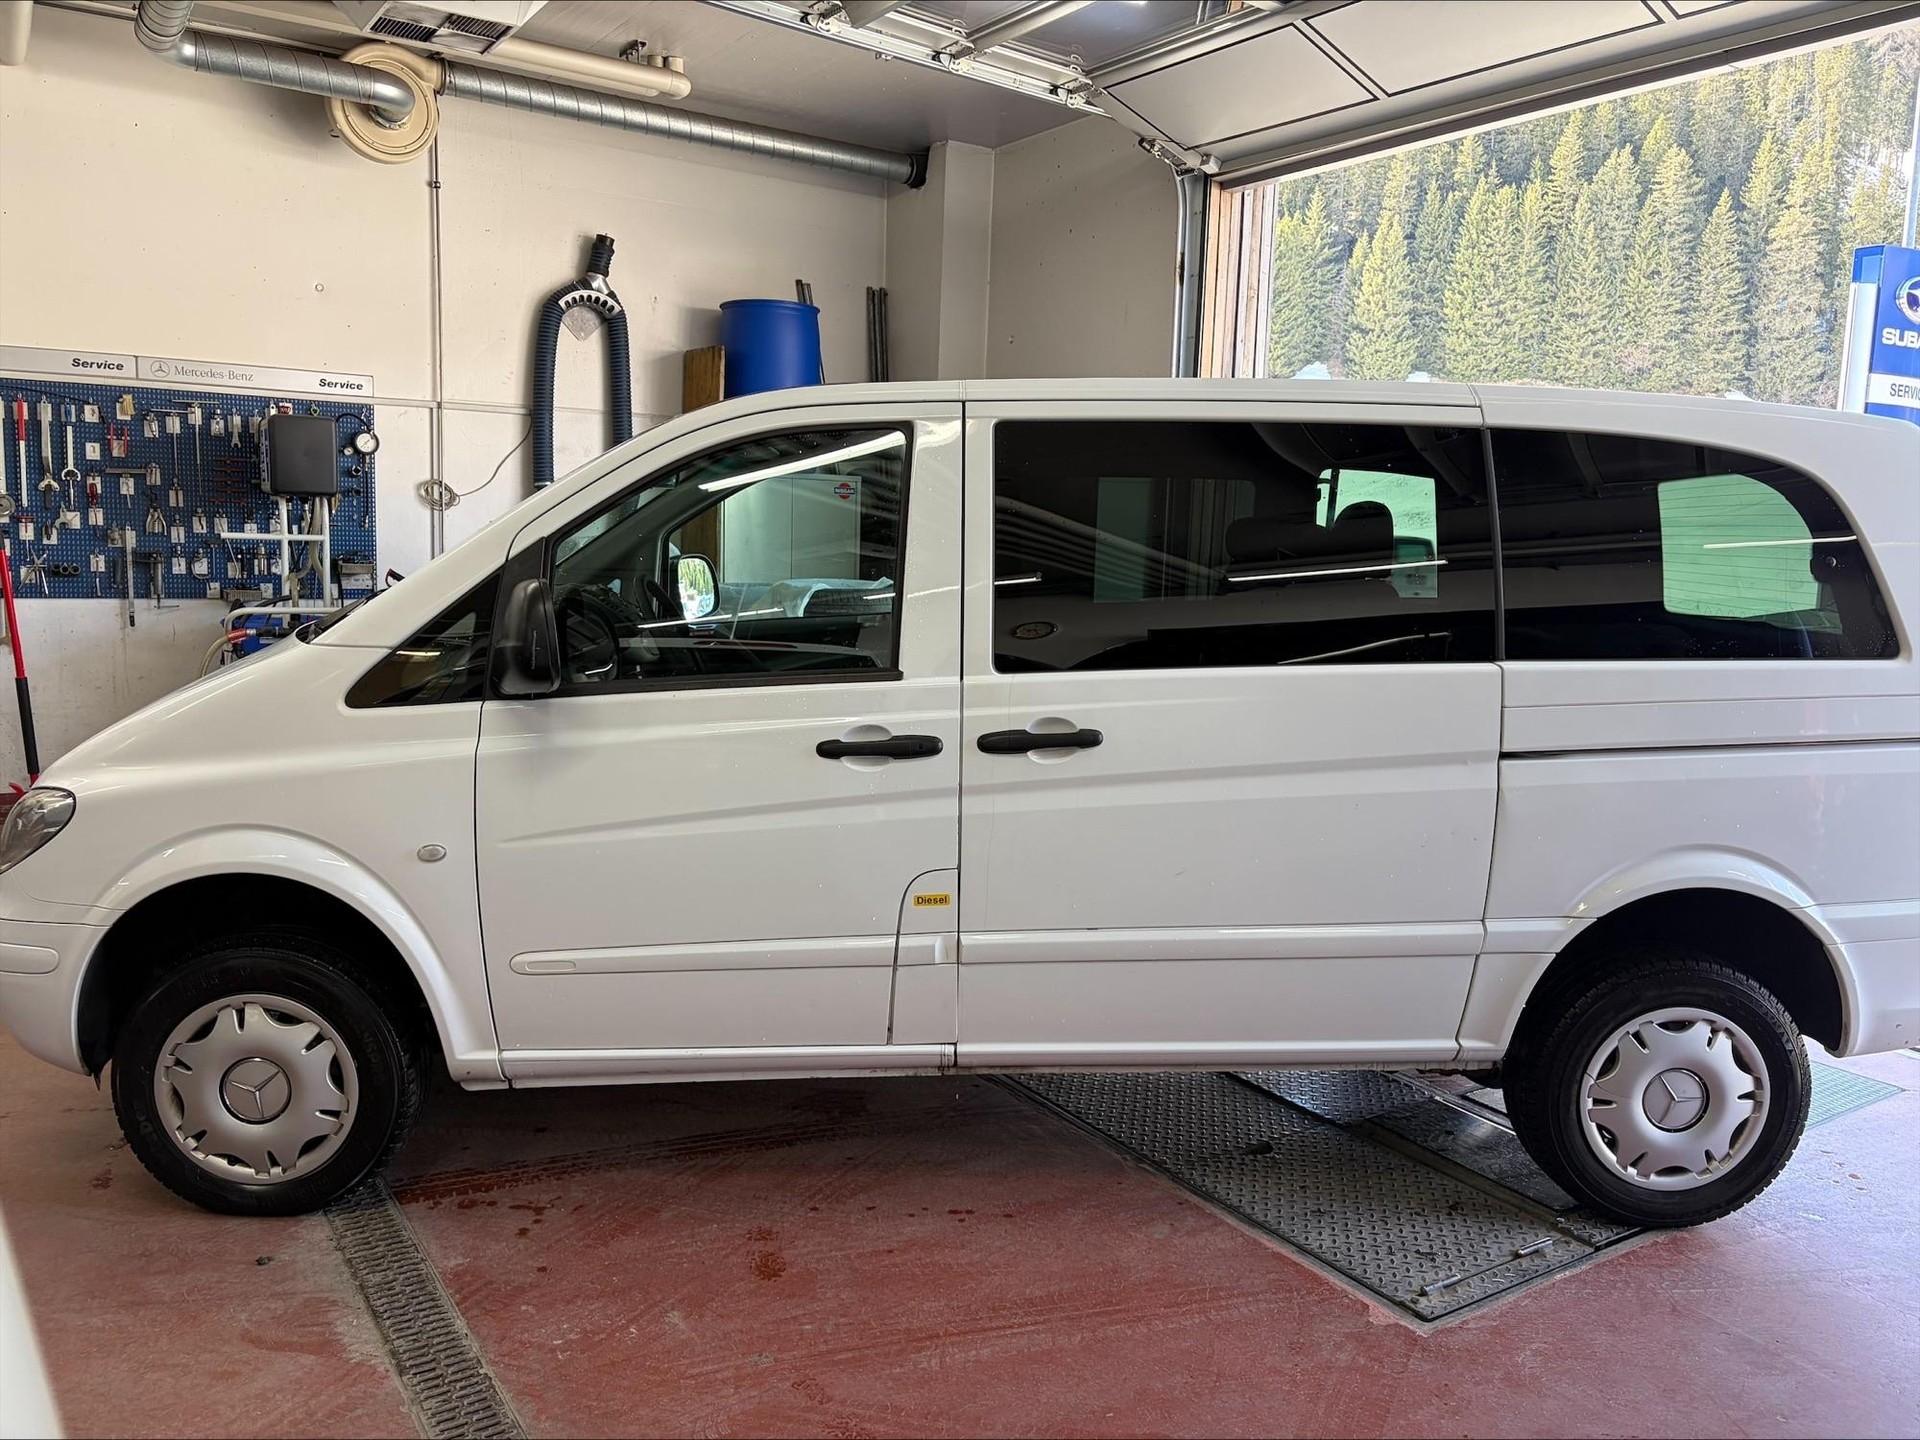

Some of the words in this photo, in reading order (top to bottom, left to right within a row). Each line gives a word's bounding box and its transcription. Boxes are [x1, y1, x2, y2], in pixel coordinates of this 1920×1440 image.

[71, 357, 125, 371] Service
[174, 365, 254, 382] Mercedes-Benz
[318, 378, 364, 391] Service
[917, 896, 947, 905] Diesel
